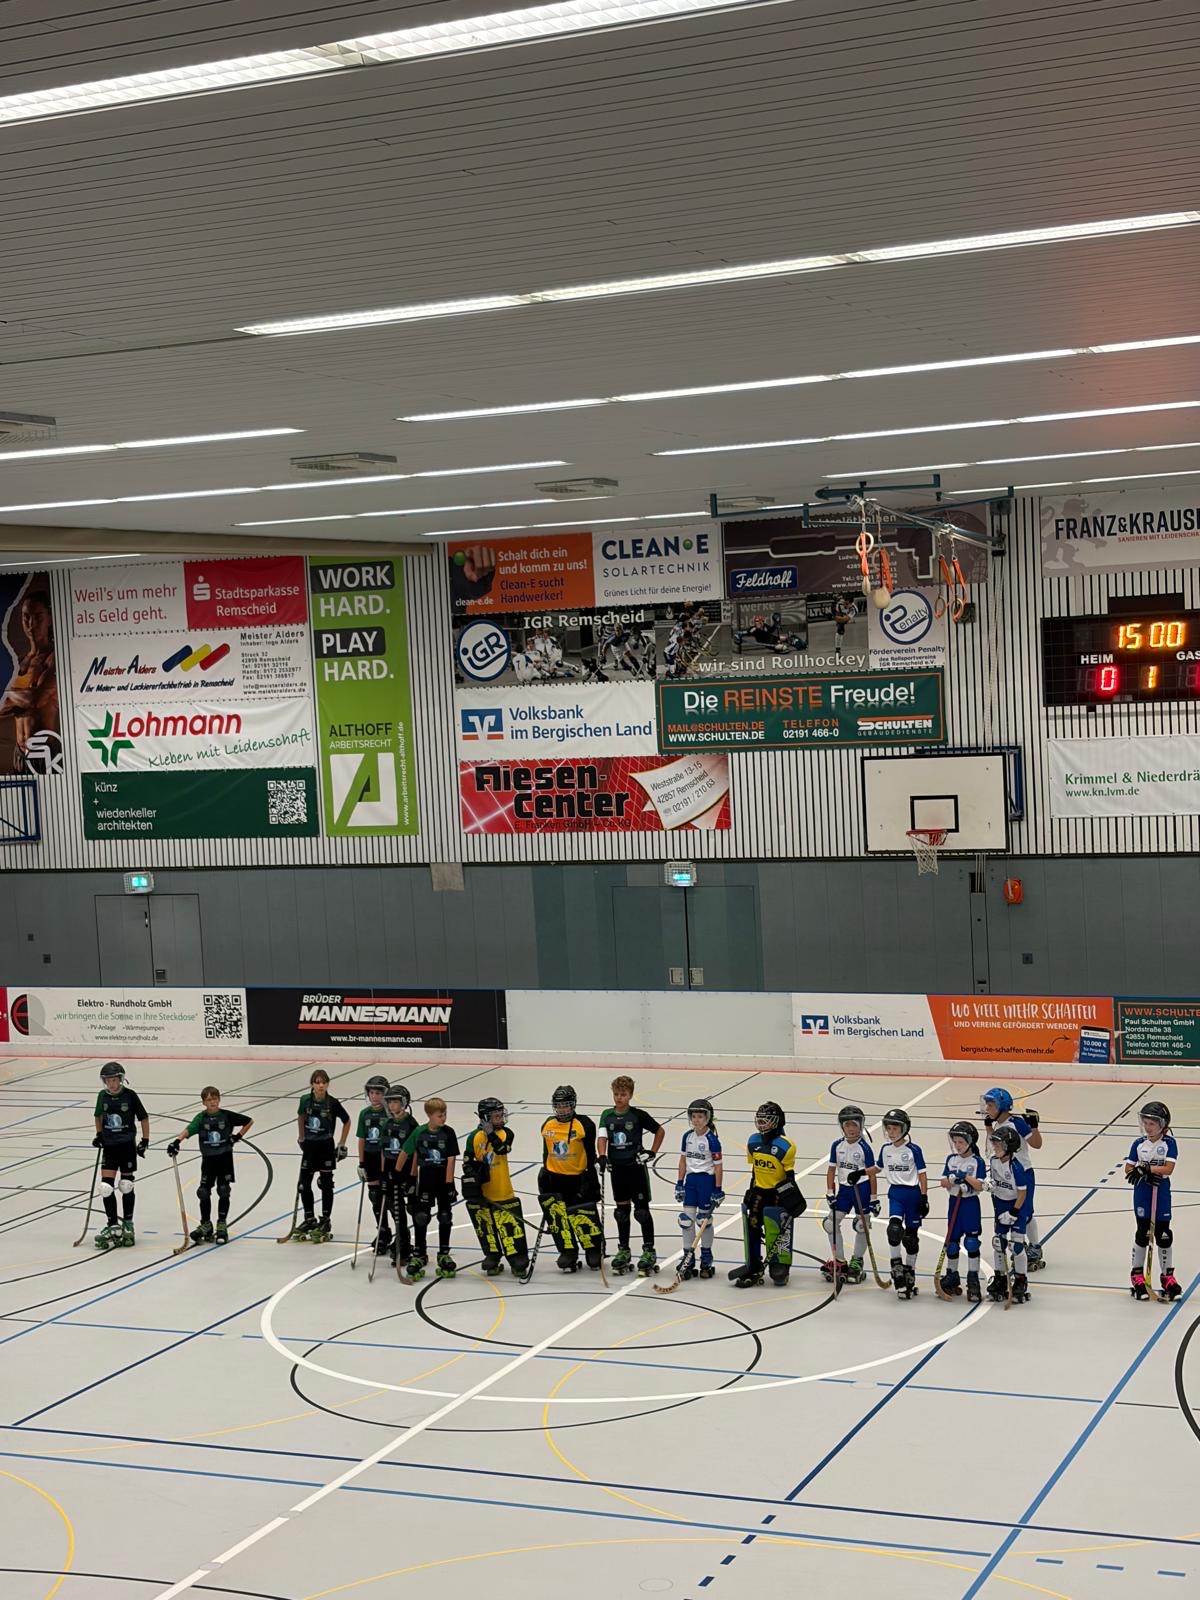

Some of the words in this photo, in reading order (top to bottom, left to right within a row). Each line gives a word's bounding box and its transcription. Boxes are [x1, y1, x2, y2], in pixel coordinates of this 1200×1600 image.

[498, 550, 528, 562] Schalt
[530, 548, 550, 560] dich
[552, 547, 568, 558] ein
[499, 563, 515, 575] und
[517, 561, 549, 573] komm
[551, 562, 564, 571] zu
[567, 559, 587, 570] uns!
[603, 561, 710, 577] SOLARTECHNIK
[318, 564, 392, 590] WORK
[500, 578, 536, 590] Clean-E
[538, 577, 564, 589] sucht
[735, 569, 792, 588] Feldhoff
[75, 586, 113, 603] Weil's
[117, 587, 139, 600] um
[143, 583, 177, 599] mehr
[215, 584, 301, 601] Stadtsparkasse
[500, 591, 564, 603] Handwerker!
[603, 588, 628, 599] Grünes
[630, 586, 646, 596] Licht
[648, 585, 660, 594] für
[660, 584, 681, 594] deine
[682, 583, 711, 595] Energie!
[320, 594, 391, 618] HARD.
[455, 597, 494, 607] clean-e.de
[77, 609, 95, 624] als
[99, 606, 128, 622] Geld
[133, 606, 167, 624] geht.
[217, 603, 277, 617] Remscheid
[523, 615, 553, 629] IGR
[558, 610, 644, 627] Remscheid
[240, 632, 272, 641] Meister
[275, 631, 305, 639] Alders
[321, 631, 378, 655] PLAY
[869, 647, 916, 655] Förderverein
[918, 645, 945, 654] Penalty
[699, 659, 724, 673] wir
[731, 656, 765, 671] sind
[772, 652, 866, 671] Rollhockey
[1080, 653, 1114, 664] HEIM
[324, 660, 395, 682] HARD.
[1148, 665, 1157, 688] 1
[117, 683, 130, 691] und
[200, 678, 235, 688] Remscheid
[1101, 666, 1117, 691] 0
[684, 690, 719, 710] Die
[724, 687, 824, 708] REINSTE
[830, 682, 915, 704] Freude!
[508, 704, 584, 720] Volksbank
[112, 711, 242, 738] Lohmann
[329, 722, 393, 737] ALTHOFF
[667, 720, 765, 733] MAIL@SCHULTEN.DE
[783, 718, 840, 729] TELEFON
[857, 719, 933, 731] SCHULTEN
[511, 725, 528, 740] im
[532, 723, 614, 742] Bergischen
[616, 721, 652, 736] Land
[668, 731, 765, 743] WWW.SCHULTEN.DE
[783, 728, 809, 739] 02191
[811, 728, 839, 738] 466-0
[857, 729, 933, 737] GEBÄUDEDIENSTE
[148, 752, 193, 767] Kleben
[197, 743, 221, 759] mit
[224, 728, 311, 756] Leidenschaft
[329, 738, 392, 749] ARBEITSRECHT
[398, 721, 411, 825] www.arbeitsrecht-althoff.de
[649, 773, 685, 792] Weststraße
[684, 760, 703, 776] 13-15
[1065, 772, 1117, 785] Krimmel
[1122, 772, 1132, 784] &
[95, 781, 118, 793] künz
[676, 769, 709, 795] Remscheid
[1065, 786, 1140, 797] www.kn.lvm.de
[513, 790, 631, 819] Center
[672, 796, 692, 813] 02191
[695, 785, 707, 798] 210
[96, 807, 157, 819] wiedenkeller
[97, 820, 153, 832] architekten
[526, 820, 561, 829] Franken
[563, 819, 591, 829] GmbH
[77, 1000, 104, 1008] Elektro
[110, 1000, 147, 1008] Rundholz
[148, 1000, 172, 1008] GmbH
[302, 993, 342, 1004] BRÜDER
[299, 1005, 452, 1023] MANNESMANN
[951, 1002, 970, 1018] WO
[69, 1012, 96, 1022] bringen
[98, 1012, 110, 1020] die
[112, 1012, 134, 1021] Sonne
[134, 1012, 142, 1020] in
[143, 1012, 158, 1020] Ihre
[832, 1015, 881, 1025] Volksbank
[1141, 1018, 1172, 1026] Schulten
[1173, 1019, 1195, 1027] GmbH
[971, 1021, 1001, 1029] VEREINE
[1003, 1020, 1044, 1030] GEFÖRDERT
[1046, 1022, 1078, 1030] WERDEN
[833, 1026, 845, 1036] im
[847, 1026, 898, 1038] Bergischen
[900, 1028, 924, 1037] Land
[330, 1034, 423, 1044] www.br-mannesmann.com
[960, 1045, 1055, 1055] bergische-schaffen-mehr.de
[1126, 1048, 1183, 1056] mail@schulten.de
